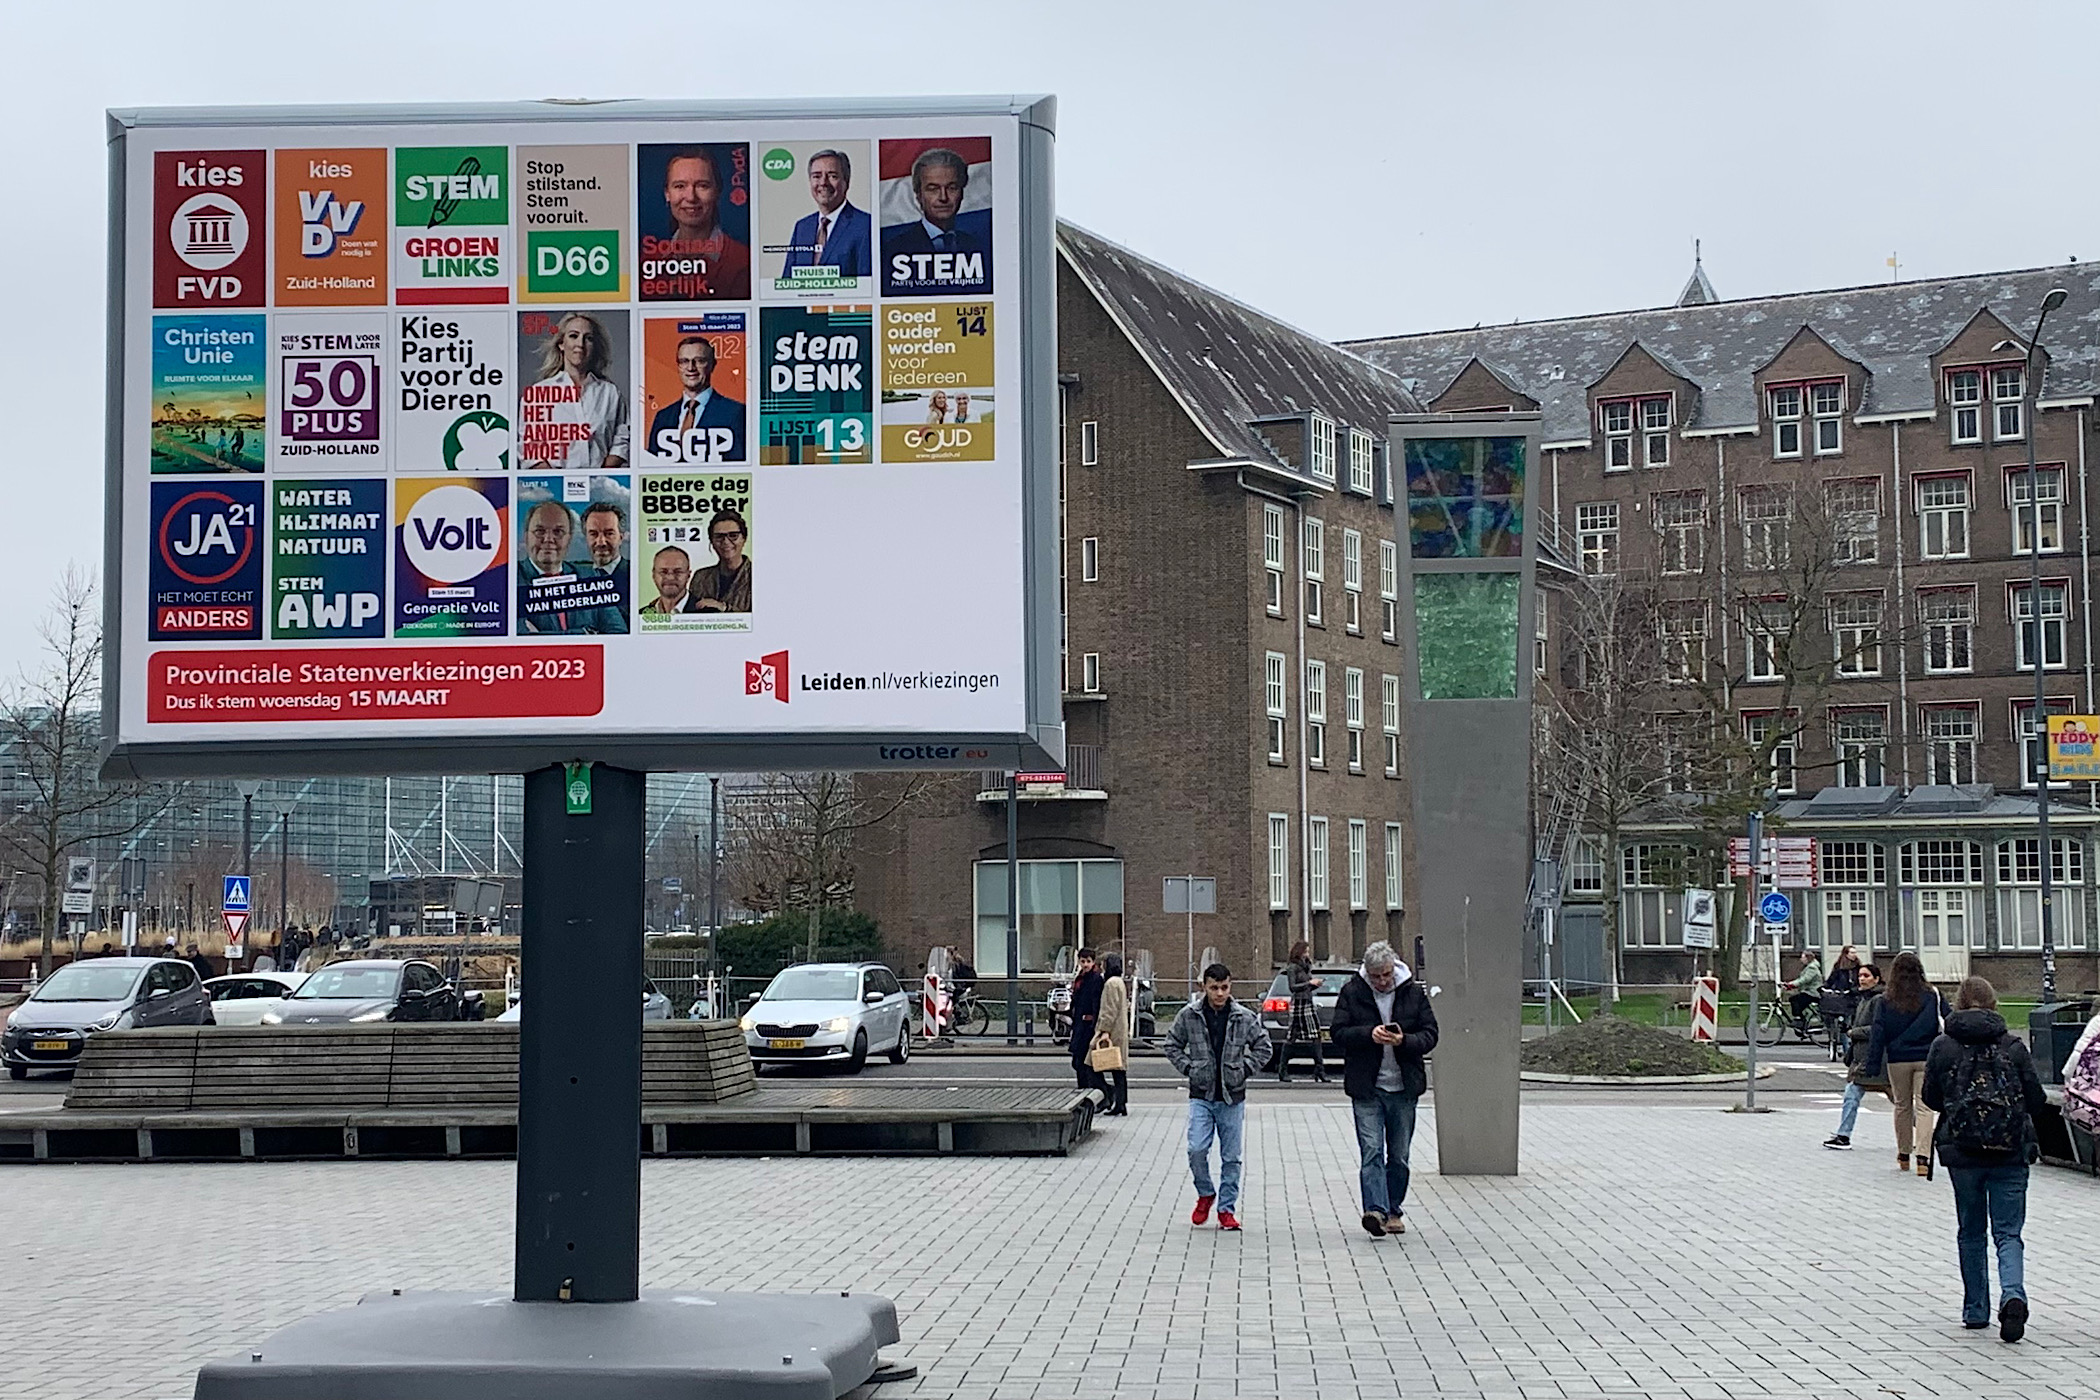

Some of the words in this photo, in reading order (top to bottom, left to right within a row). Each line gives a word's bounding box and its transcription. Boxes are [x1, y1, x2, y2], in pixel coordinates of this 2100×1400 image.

[177, 159, 243, 187] kies
[309, 160, 353, 179] kies
[526, 160, 564, 177] Stop
[731, 147, 746, 186] PvdA
[764, 159, 793, 170] CDA
[406, 174, 499, 201] STEM
[526, 177, 602, 191] stilstand.
[526, 193, 569, 208] Stem
[298, 190, 365, 258] VVD
[526, 210, 589, 224] vooruit.
[341, 249, 363, 258] nodig
[405, 236, 499, 258] GROEN
[641, 235, 724, 255] Sociaal
[421, 258, 499, 278] LINKS
[537, 245, 610, 277] D66
[642, 258, 707, 281] groen
[891, 252, 984, 281] STEM
[794, 268, 825, 277] THUIS
[827, 267, 839, 276] IN
[177, 277, 242, 300] FVD
[286, 276, 375, 290] Zuid-Holland
[641, 276, 715, 298] eerlijk.
[775, 278, 857, 289] ZUID-HOLLAND
[891, 279, 914, 288] PARTIJ
[914, 279, 936, 287] VOOR
[949, 278, 984, 286] VRIJHEID
[887, 307, 936, 324] Goed
[956, 306, 988, 316] LIJST
[401, 316, 460, 339] Kies
[887, 324, 942, 340] ouder
[956, 316, 988, 337] 14
[164, 328, 254, 346] Christen
[281, 335, 299, 343] KIES
[301, 335, 353, 350] STEM
[356, 334, 380, 342] VOOR
[355, 341, 380, 349] LATER
[775, 331, 858, 361] stem
[184, 346, 234, 364] Unie
[401, 340, 473, 368] Partij
[708, 335, 741, 359] 12
[887, 339, 957, 355] worden
[888, 357, 929, 369] voor
[164, 375, 196, 383] RUIMTE
[197, 374, 221, 382] VOOR
[222, 374, 254, 382] ELKAAR
[291, 360, 366, 408] 50
[400, 369, 463, 387] voor
[469, 363, 503, 386] de
[770, 363, 863, 393] DENK
[888, 370, 967, 385] iedereen
[401, 388, 492, 411] Dieren
[523, 385, 582, 403] OMDAT
[292, 412, 363, 434] PLUS
[523, 405, 555, 422] HET
[523, 423, 591, 442] ANDERS
[769, 420, 815, 435] LIJST
[816, 418, 865, 451] 13
[904, 427, 972, 453] GOUD
[280, 443, 379, 456] ZUID-HOLLAND
[523, 442, 570, 461] MOET
[656, 427, 734, 463] SGP
[642, 477, 705, 493] Iedere
[710, 476, 749, 494] dag
[279, 489, 352, 507] WATER
[641, 493, 749, 514] BBBeter
[279, 513, 381, 531] KLIMAAT
[413, 516, 493, 551] Volt
[662, 527, 670, 542] 1
[689, 527, 701, 542] 2
[279, 538, 367, 555] NATUUR
[278, 576, 324, 591] STEM
[529, 589, 542, 599] IN
[544, 585, 567, 597] HET
[569, 579, 615, 595] BELANG
[157, 591, 182, 603] HET
[183, 591, 219, 603] MOET
[221, 590, 254, 602] ECHT
[525, 602, 550, 614] VAN
[552, 593, 621, 611] NEDERLAND
[277, 593, 380, 629] AWP
[402, 601, 469, 614] Generatie
[471, 601, 500, 613] Volt
[162, 609, 249, 628] ANDERS
[165, 662, 293, 687] Provinciale
[299, 660, 525, 684] Statenverkiezingen
[530, 659, 586, 680] 2023
[801, 670, 1000, 693] Leiden.nl/verkiezingen
[165, 694, 197, 710] Dus
[199, 693, 214, 709] ik
[216, 693, 257, 708] stem
[259, 692, 342, 712] woensdag
[348, 690, 371, 706] 15
[376, 688, 451, 706] MAART
[2050, 732, 2099, 744] TEDDY
